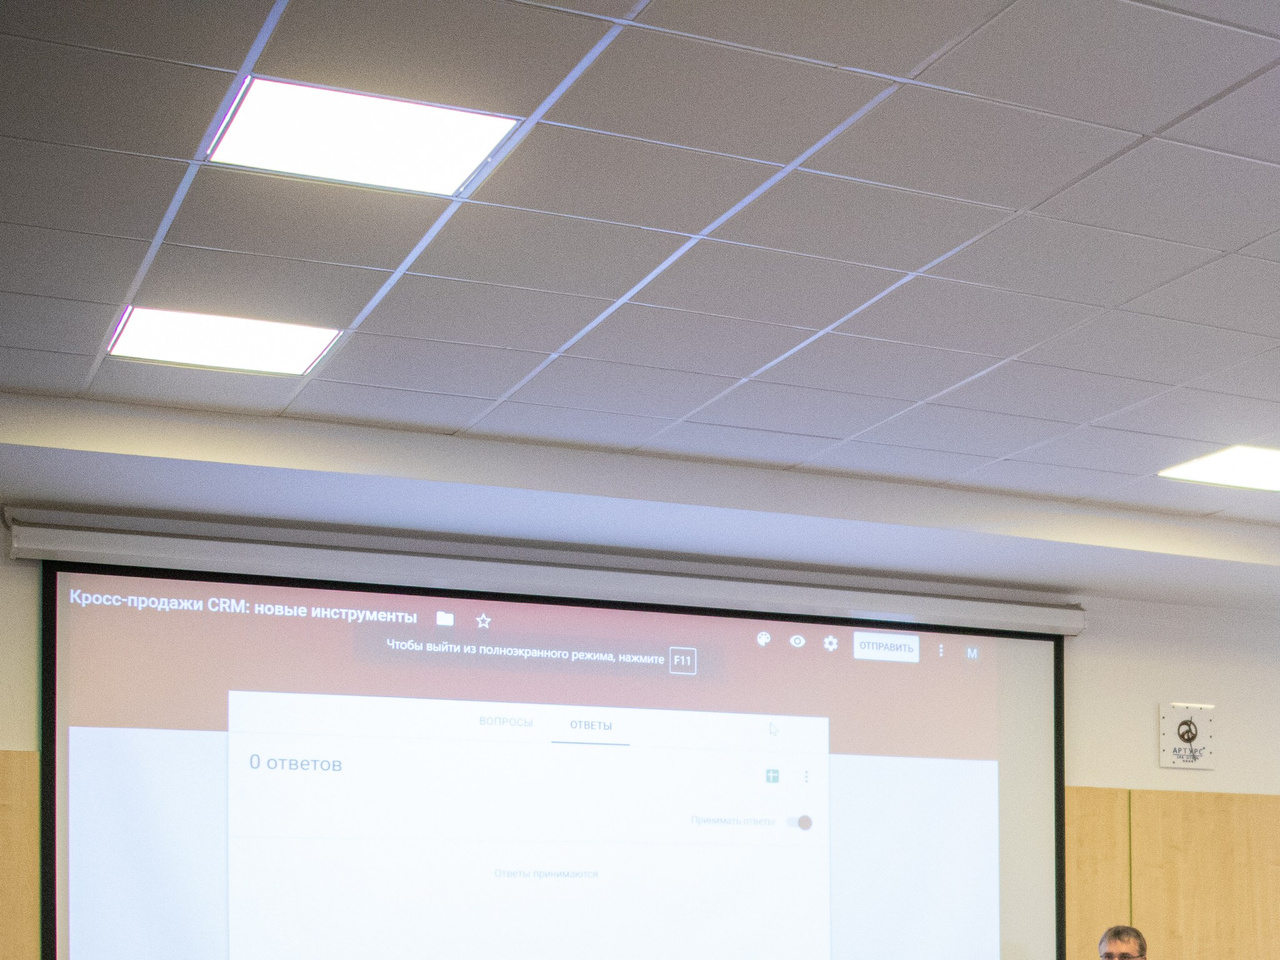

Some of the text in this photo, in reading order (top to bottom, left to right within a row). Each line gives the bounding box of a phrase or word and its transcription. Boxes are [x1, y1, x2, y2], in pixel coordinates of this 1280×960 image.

[69, 588, 418, 623] Кросс-продажи CRM: новые инструменты
[386, 638, 692, 666] Чтобы выйти из полноэкранного режима, нажмите F11
[859, 640, 914, 654] ОТПРАВИТЬ
[479, 716, 534, 728] ВОПРОСЫ
[569, 719, 613, 731] ОТВЕТЫ
[249, 753, 343, 773] 0 ответов
